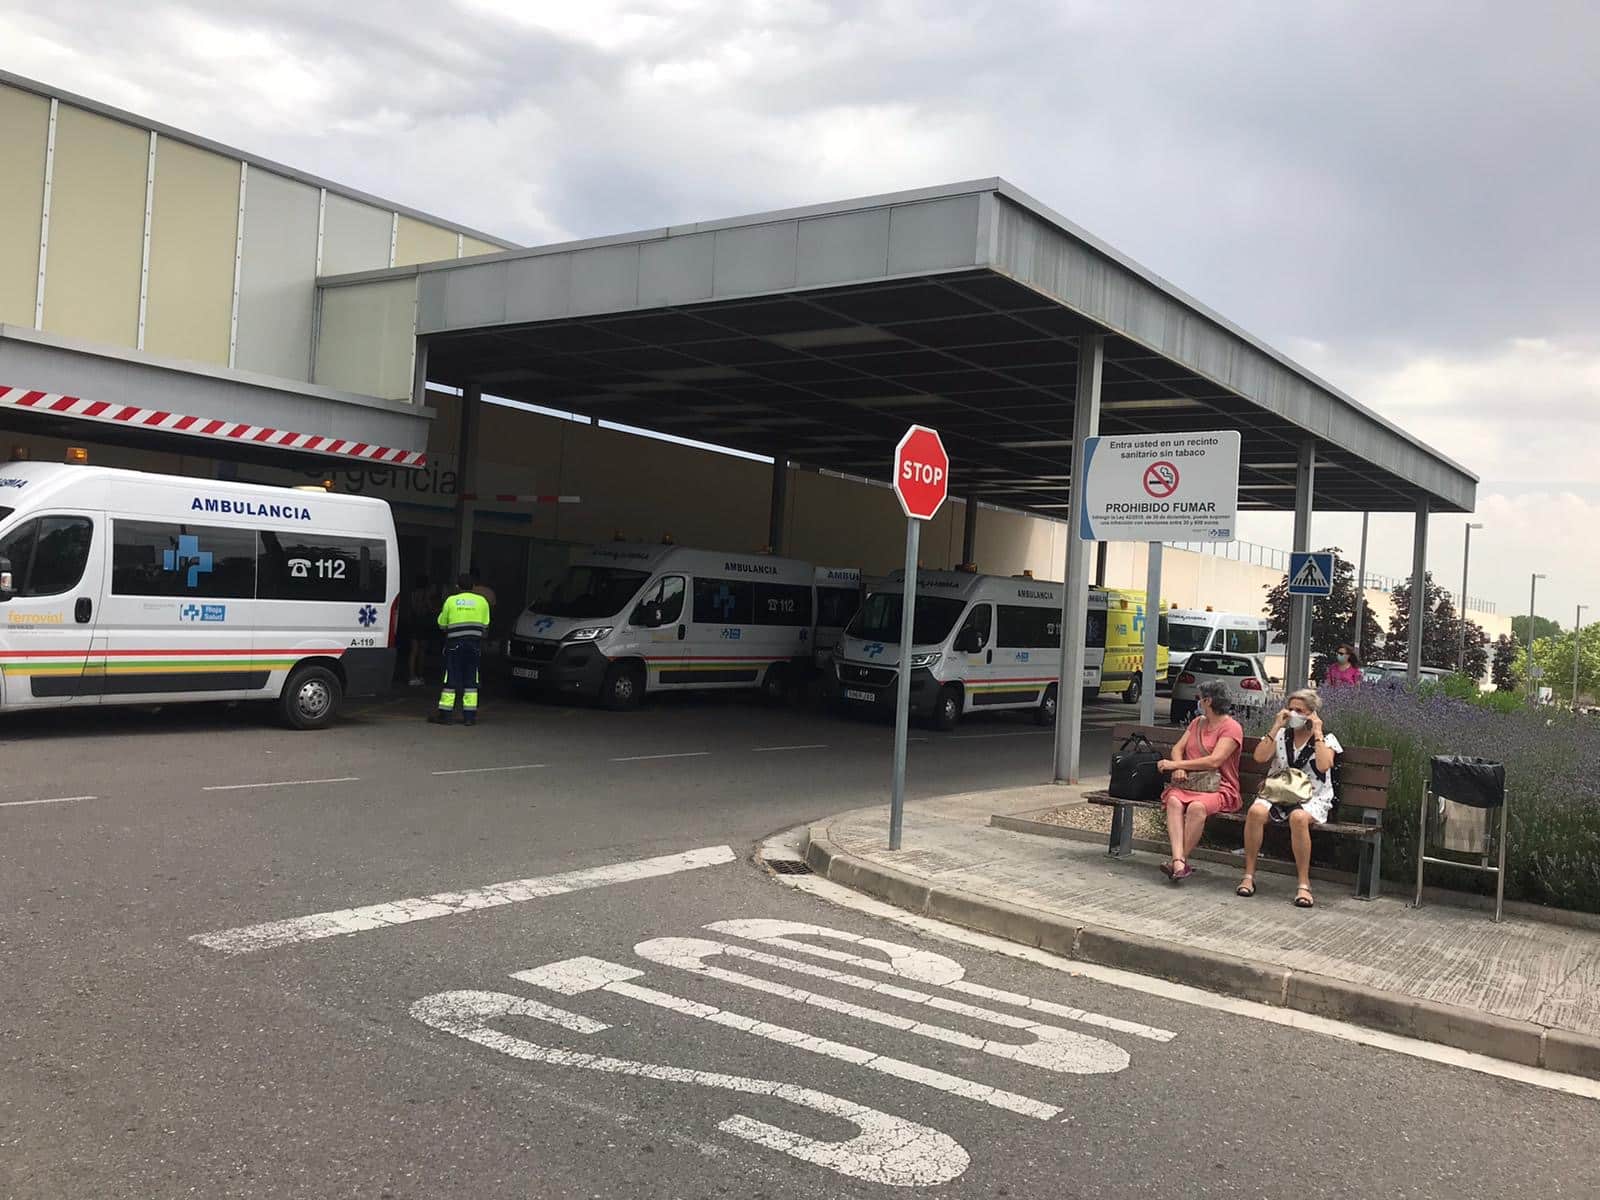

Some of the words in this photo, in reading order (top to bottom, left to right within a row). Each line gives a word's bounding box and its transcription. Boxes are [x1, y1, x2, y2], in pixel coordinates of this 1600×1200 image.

[1109, 441, 1132, 449] Entra
[1134, 440, 1158, 448] usted
[1173, 439, 1185, 447] un
[1187, 437, 1218, 446] recinto
[1120, 449, 1158, 459] sanitario
[1159, 449, 1173, 458] sin
[1175, 448, 1206, 457] tabaco
[902, 459, 943, 486] STOP
[191, 497, 312, 521] AMBULANCIA
[1105, 502, 1169, 513] PROHIBIDO
[1173, 501, 1216, 512] FUMAR
[315, 559, 346, 580] 112
[724, 561, 777, 576] AMBULANCIA
[1017, 589, 1054, 600] AMBULANCIA
[780, 599, 794, 613] 112
[8, 609, 64, 624] ferrovial
[351, 638, 375, 648] A-119
[407, 918, 1179, 1188] STOP
